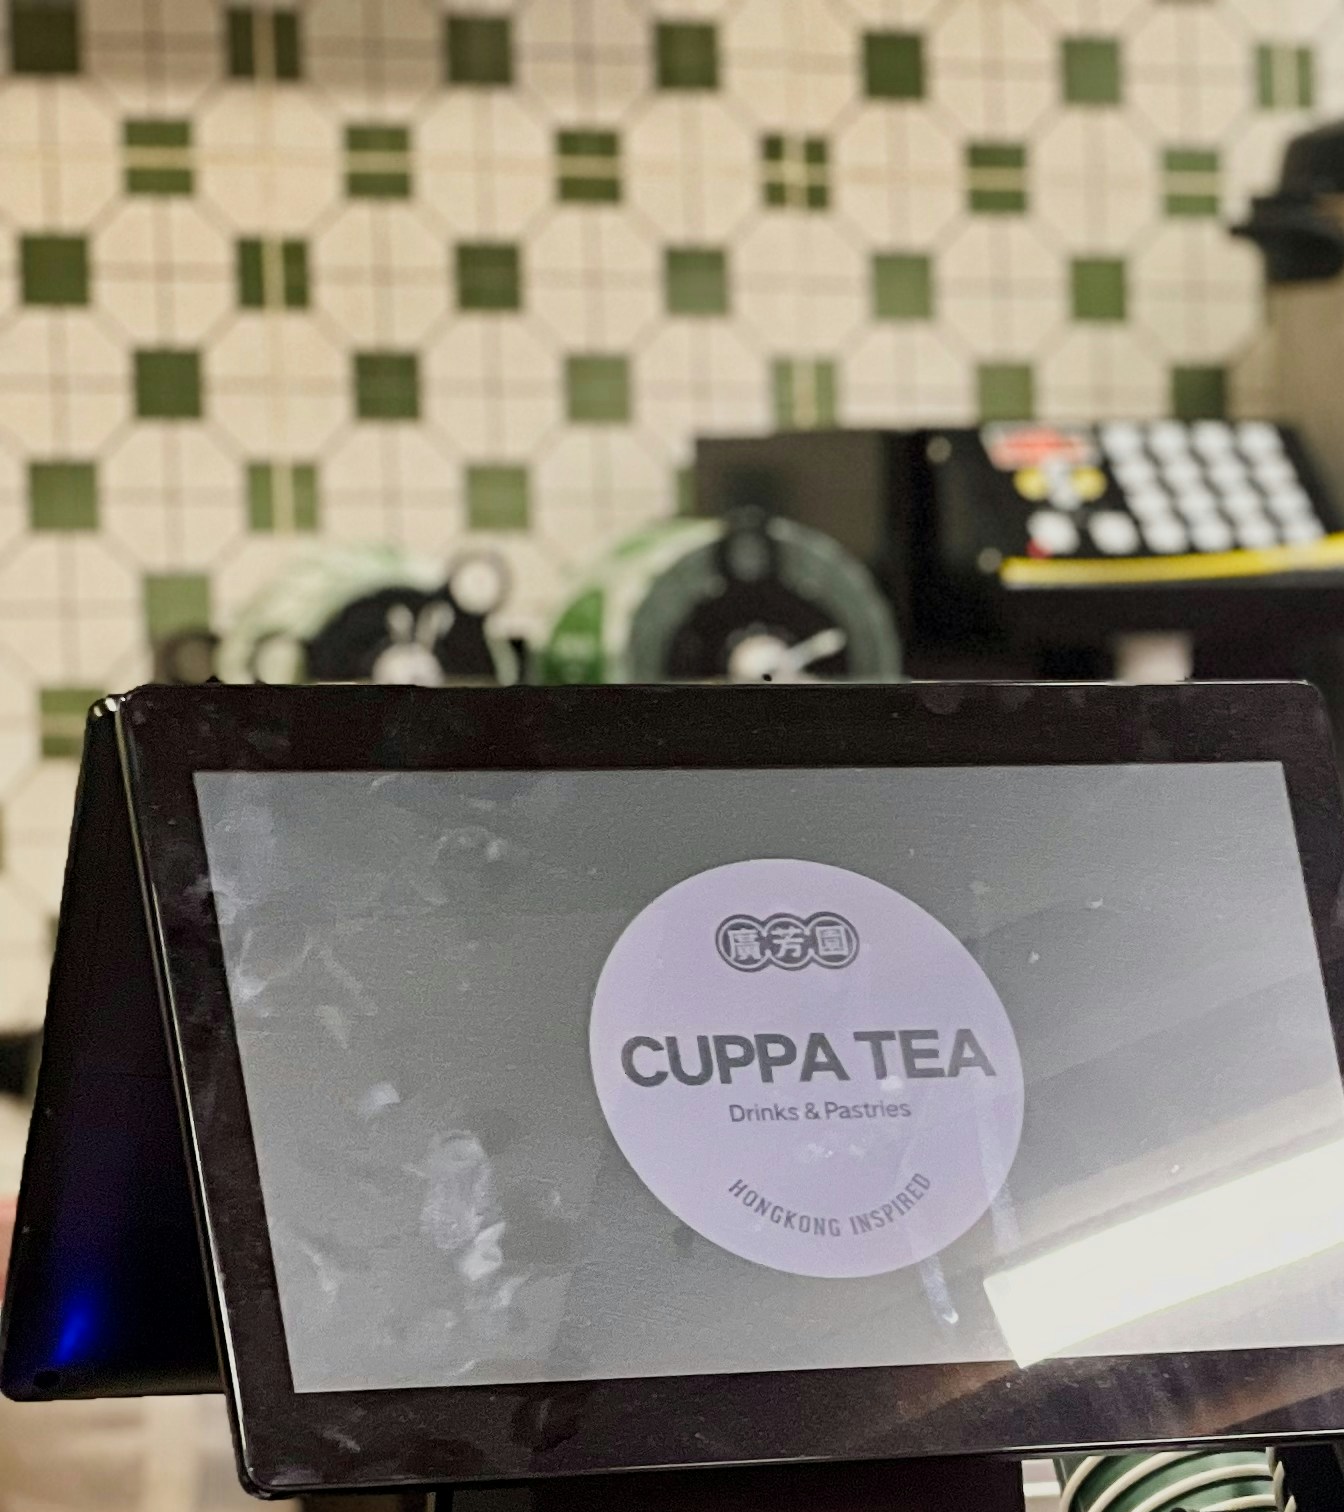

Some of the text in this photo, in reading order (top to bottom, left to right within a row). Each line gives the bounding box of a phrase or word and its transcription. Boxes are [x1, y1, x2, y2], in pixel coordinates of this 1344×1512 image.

[620, 1028, 996, 1088] CUPPA TEA
[729, 1099, 911, 1122] Drinks & Pastries
[728, 1172, 931, 1237] HONGKONG INSPIRED
